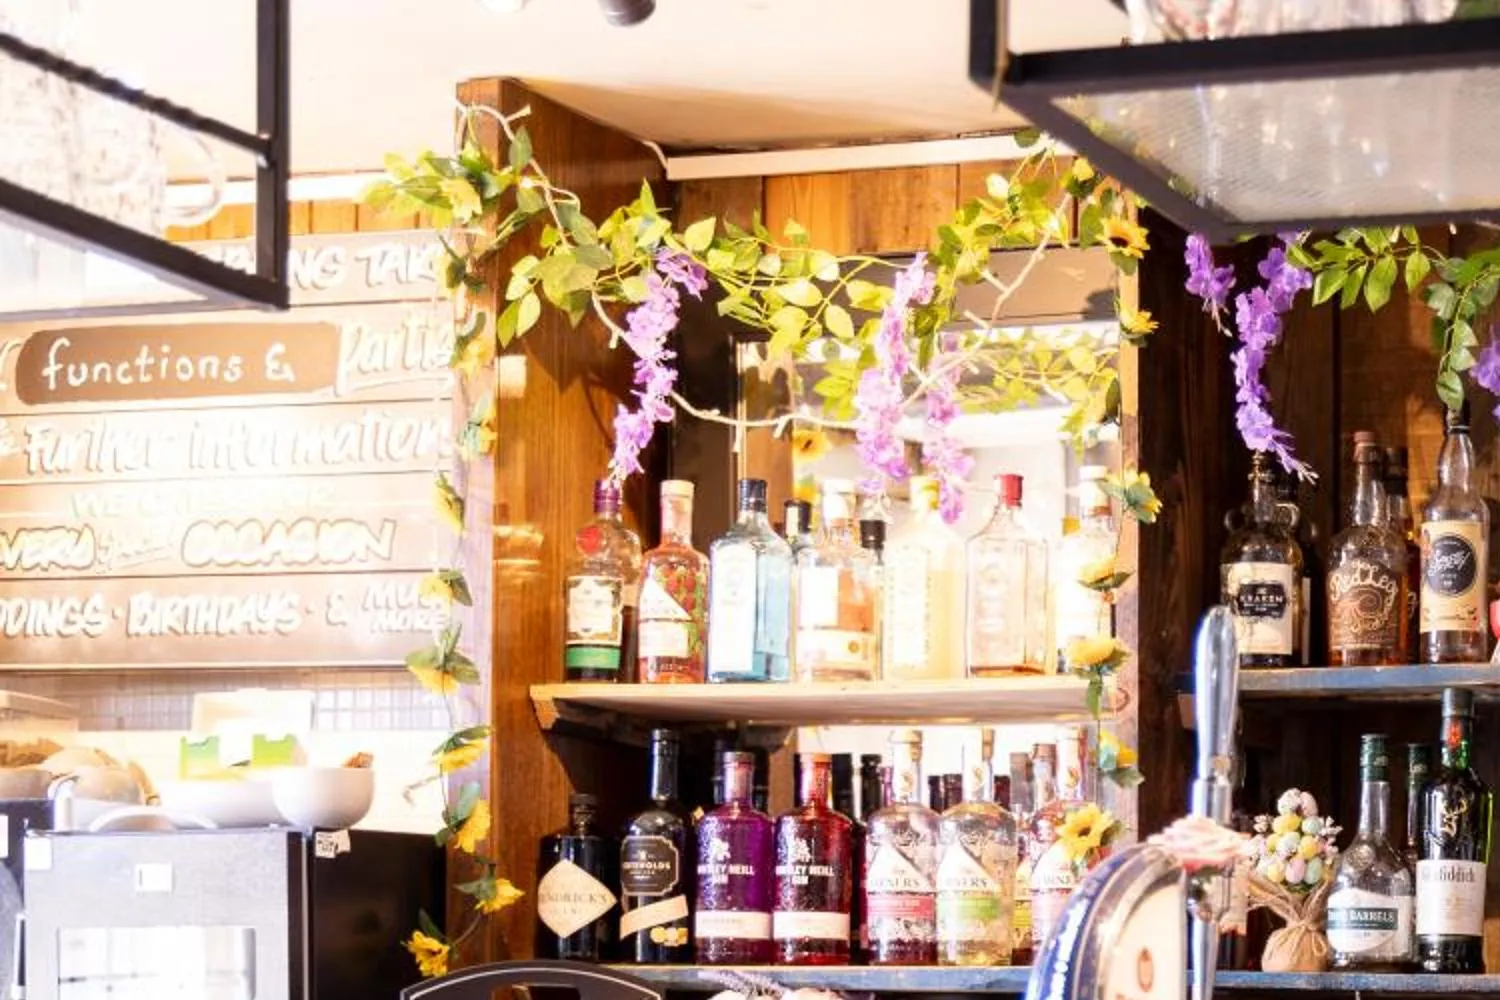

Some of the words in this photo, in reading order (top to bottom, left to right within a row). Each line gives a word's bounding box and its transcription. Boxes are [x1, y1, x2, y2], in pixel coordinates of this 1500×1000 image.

[42, 337, 242, 391] functions
[265, 342, 294, 383] &
[1349, 910, 1394, 923] BARRELS
